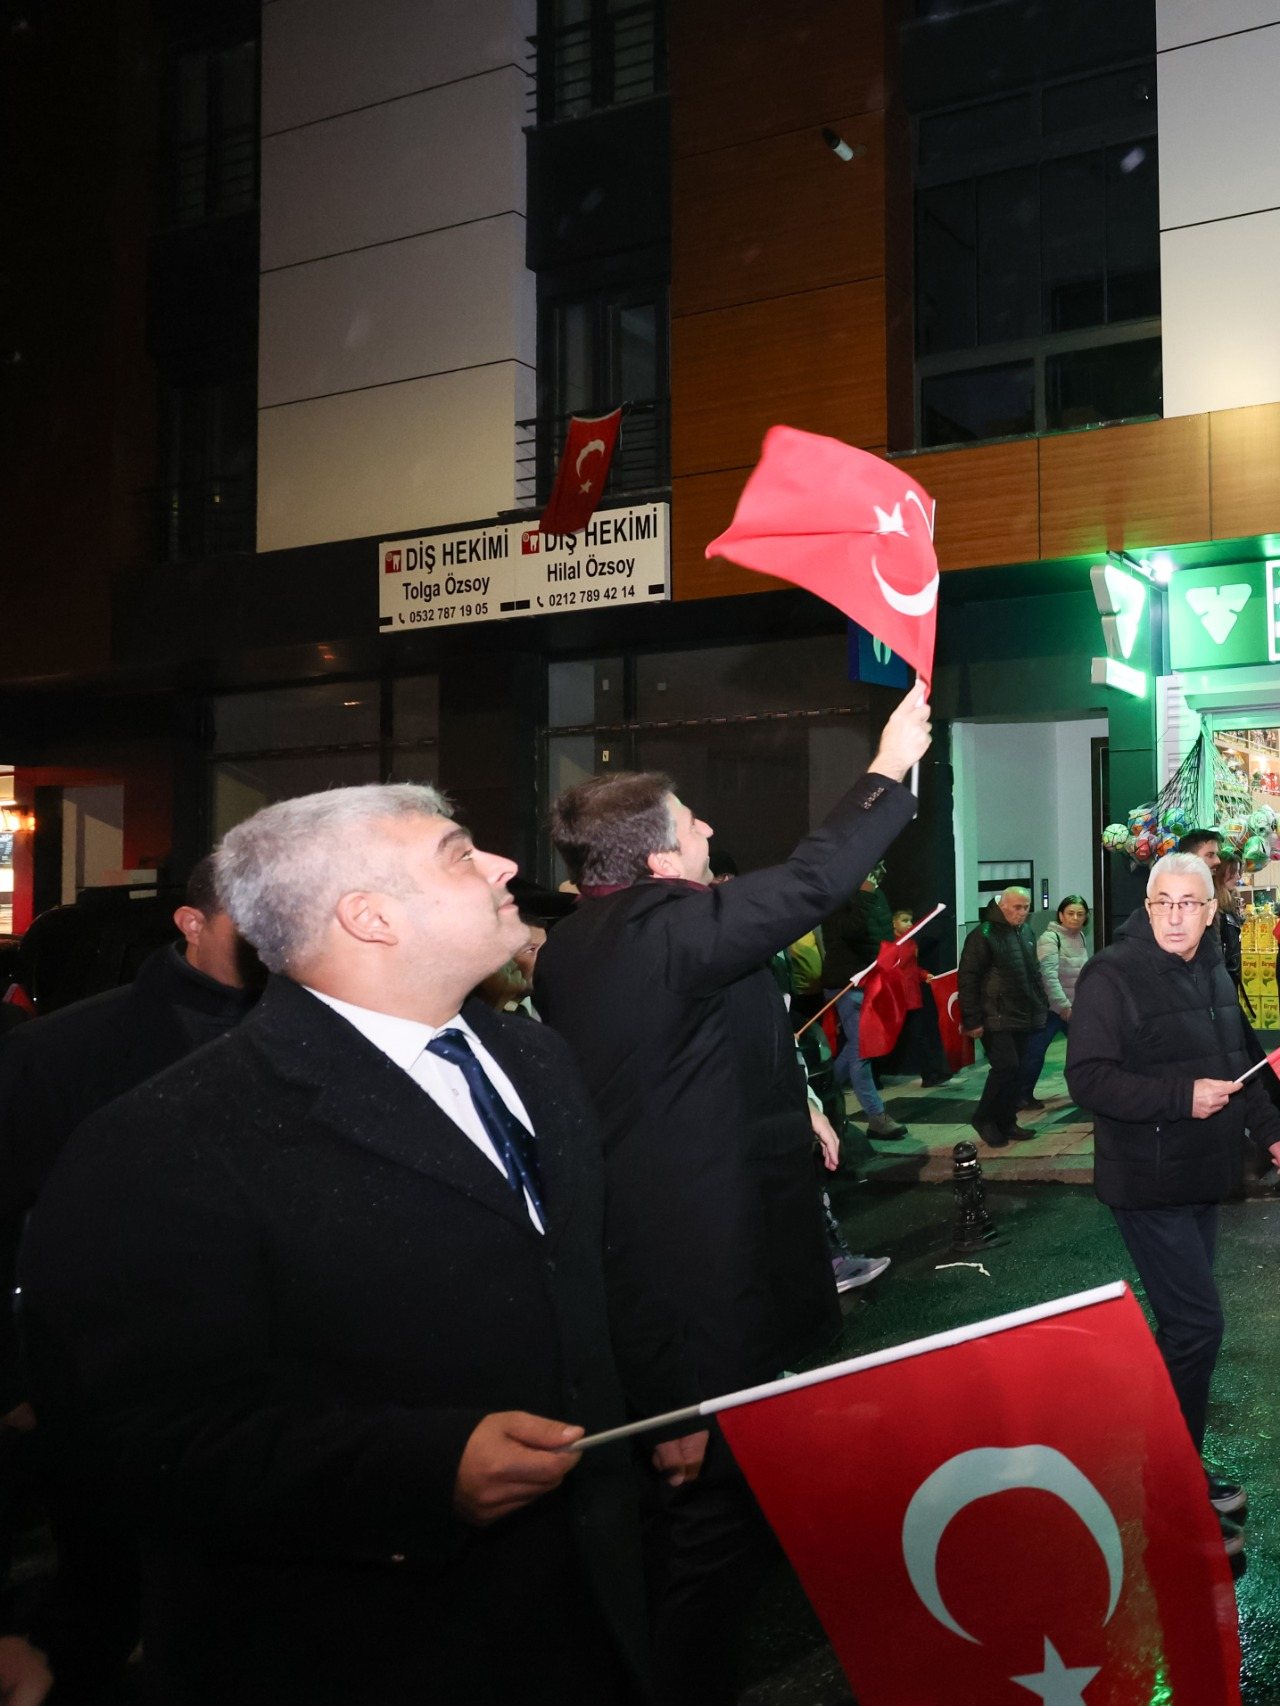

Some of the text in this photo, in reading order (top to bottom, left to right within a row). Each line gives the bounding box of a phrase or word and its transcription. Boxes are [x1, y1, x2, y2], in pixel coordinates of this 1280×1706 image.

[585, 507, 657, 547] HEKİMİ
[406, 531, 509, 574] DİŞ HEKİMİ
[547, 554, 635, 582] Hilal Özsoy
[402, 573, 490, 602] Tolga Özsoy
[549, 585, 635, 606] 0212 789 42 14
[410, 602, 488, 623] 0532 787 19 05
